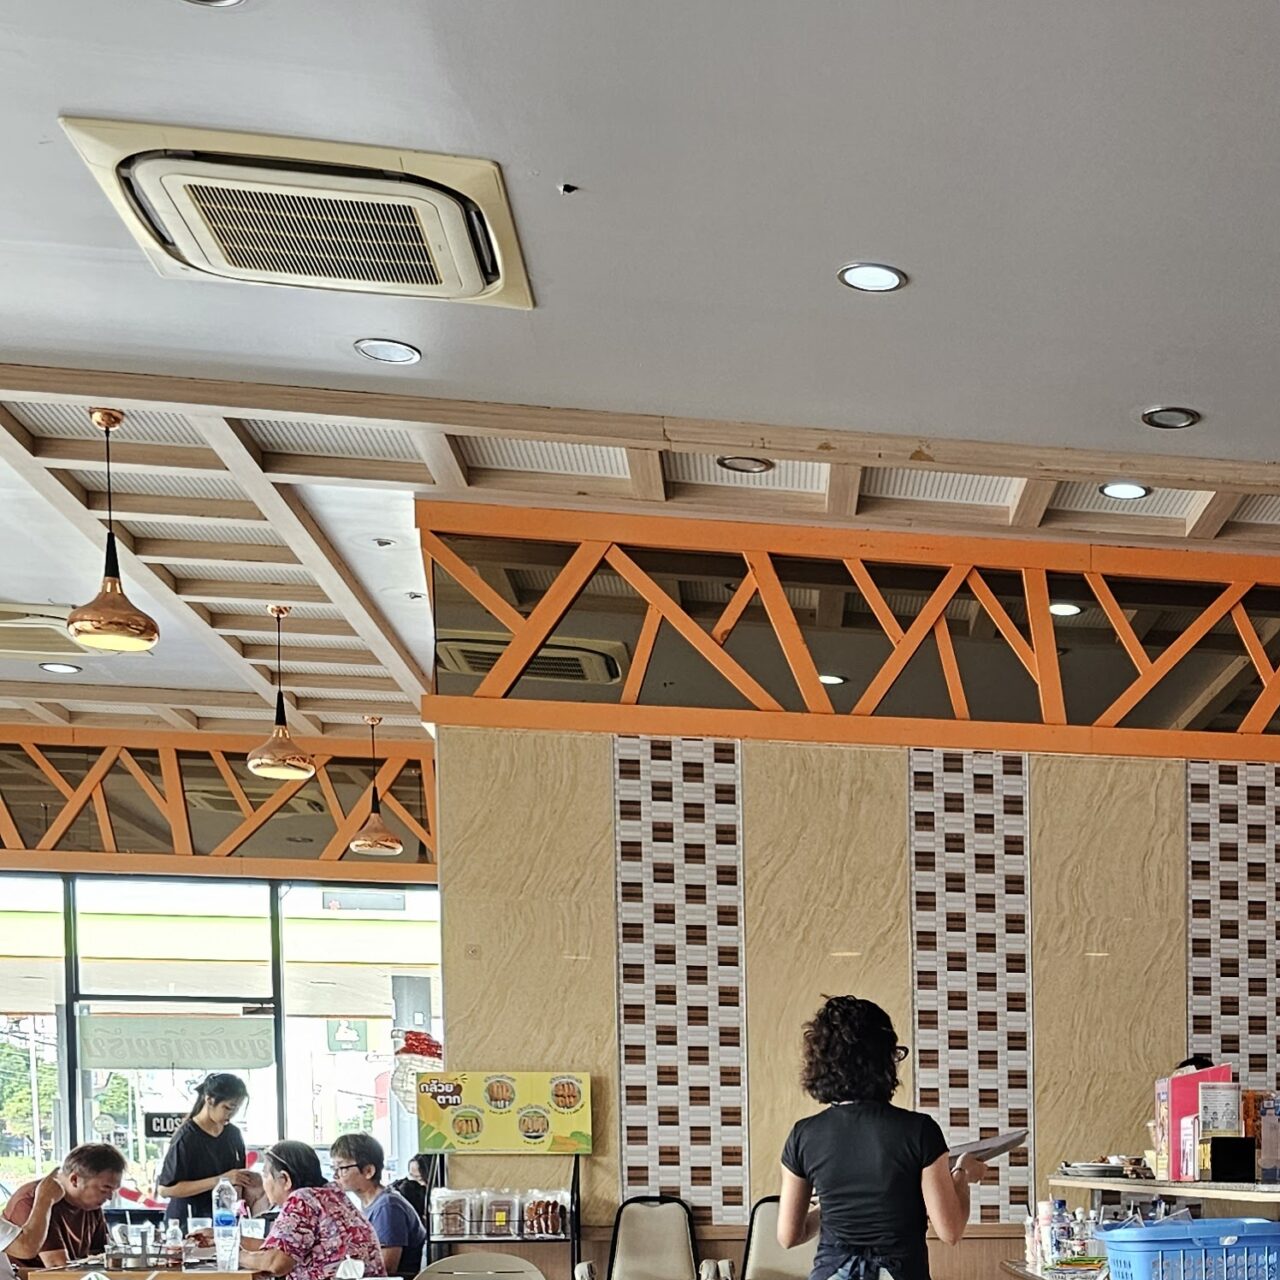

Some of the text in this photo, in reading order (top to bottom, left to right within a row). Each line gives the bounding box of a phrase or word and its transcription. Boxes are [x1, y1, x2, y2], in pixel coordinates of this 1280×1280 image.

[420, 1079, 454, 1095] กล้วย
[437, 1094, 461, 1106] ตาก
[152, 1117, 184, 1132] CLOS
